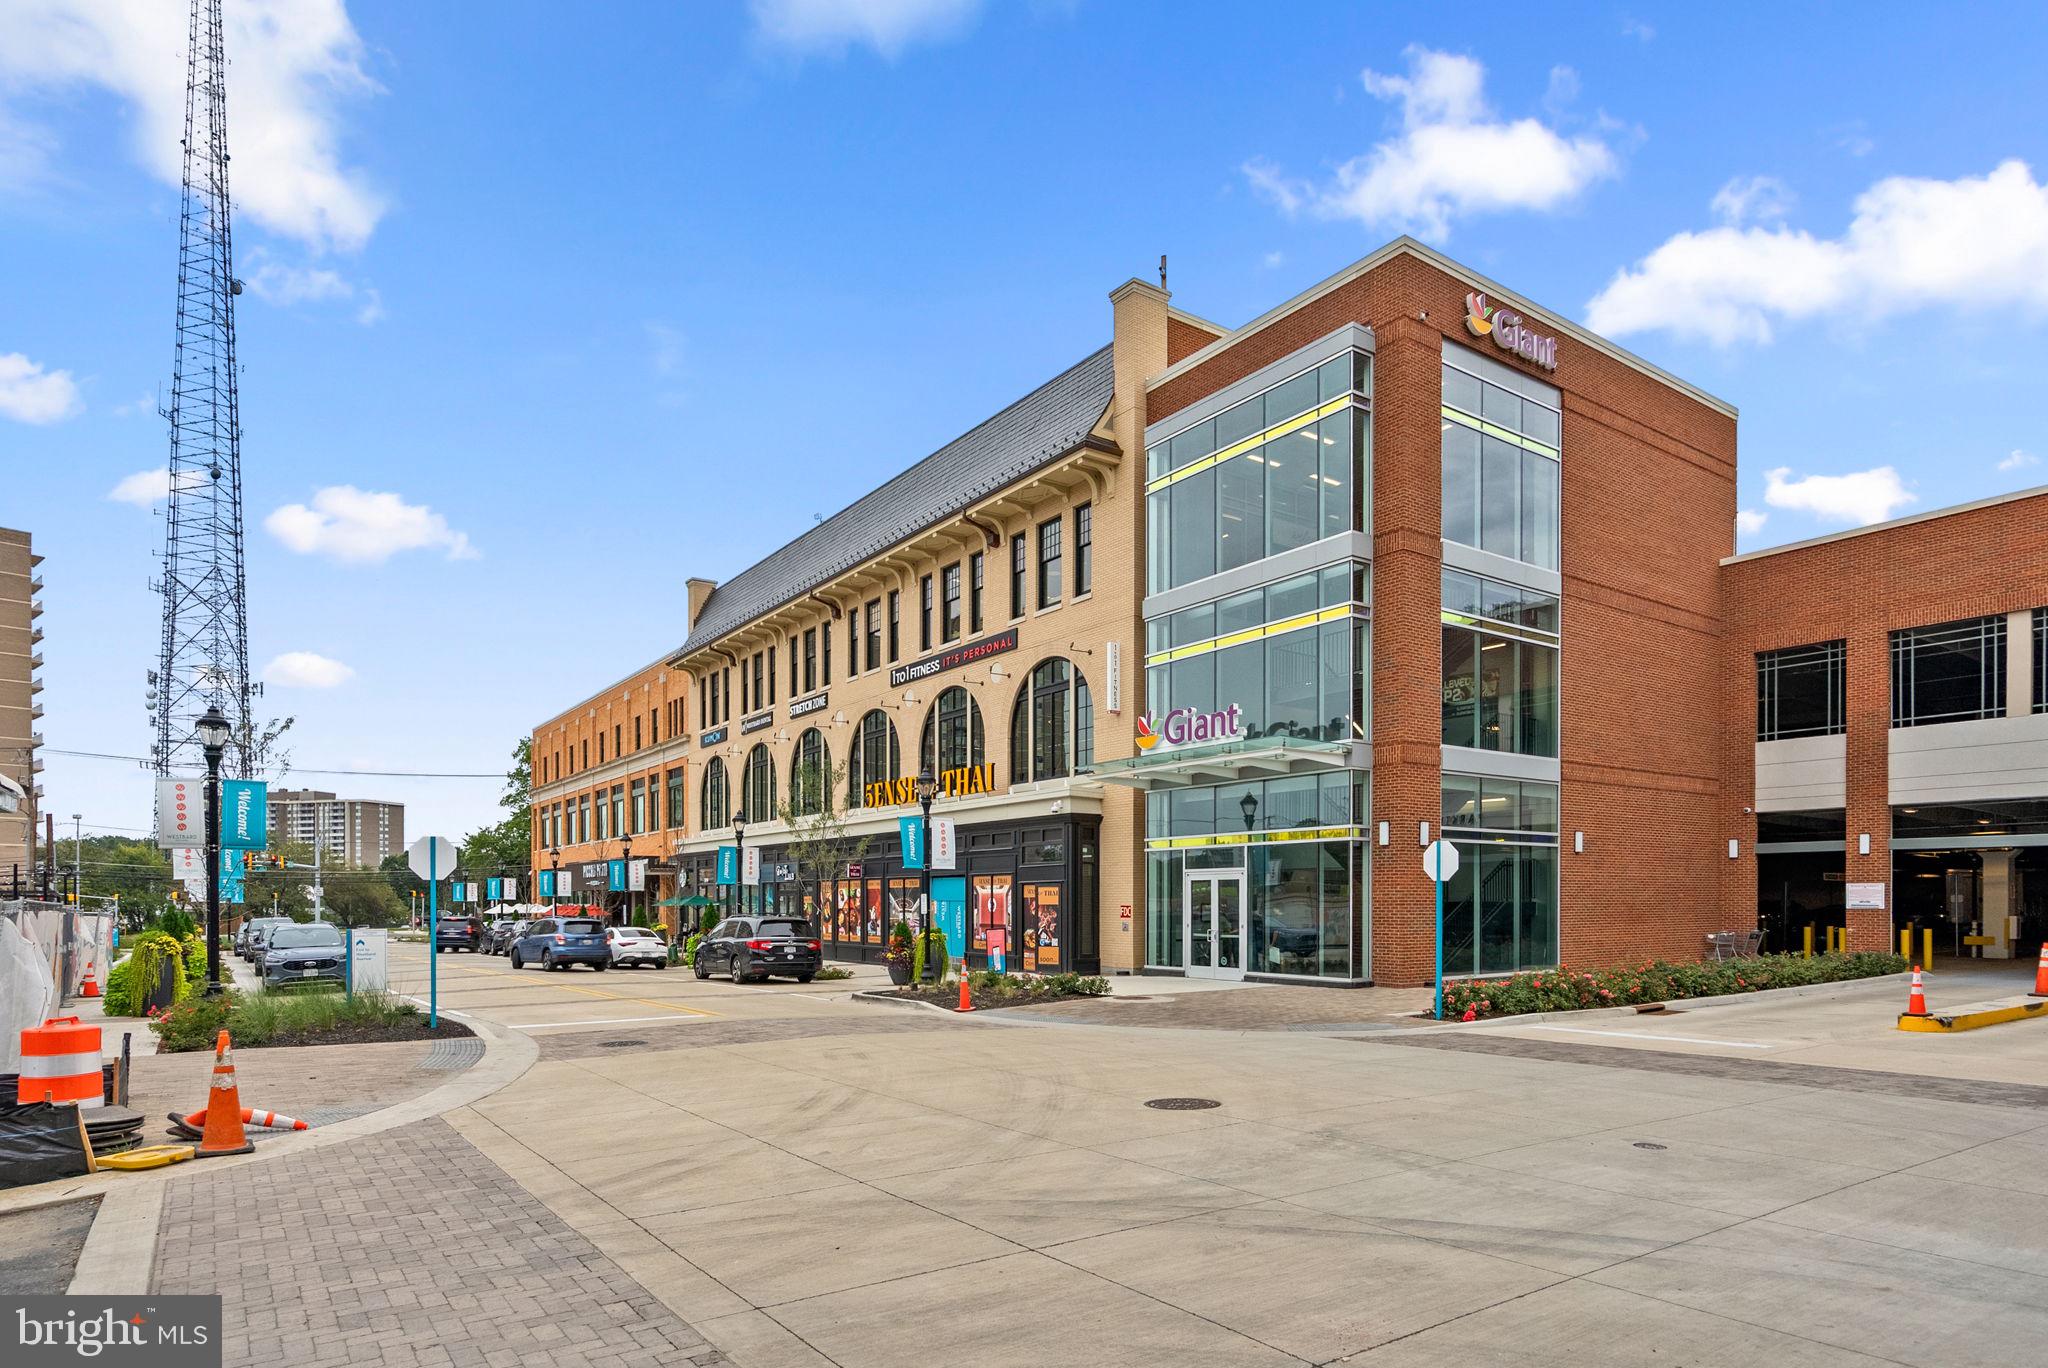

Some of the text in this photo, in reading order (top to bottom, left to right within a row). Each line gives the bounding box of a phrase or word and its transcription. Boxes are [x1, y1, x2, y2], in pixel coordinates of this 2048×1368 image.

[1492, 309, 1558, 370] Giant
[942, 654, 960, 667] IT'S
[973, 637, 1013, 660] PERSONAL
[790, 699, 812, 716] STRETCH
[1163, 703, 1242, 745] Giant
[942, 763, 995, 798] THAI
[238, 788, 251, 840] Welcome!
[907, 822, 917, 861] Welcome!
